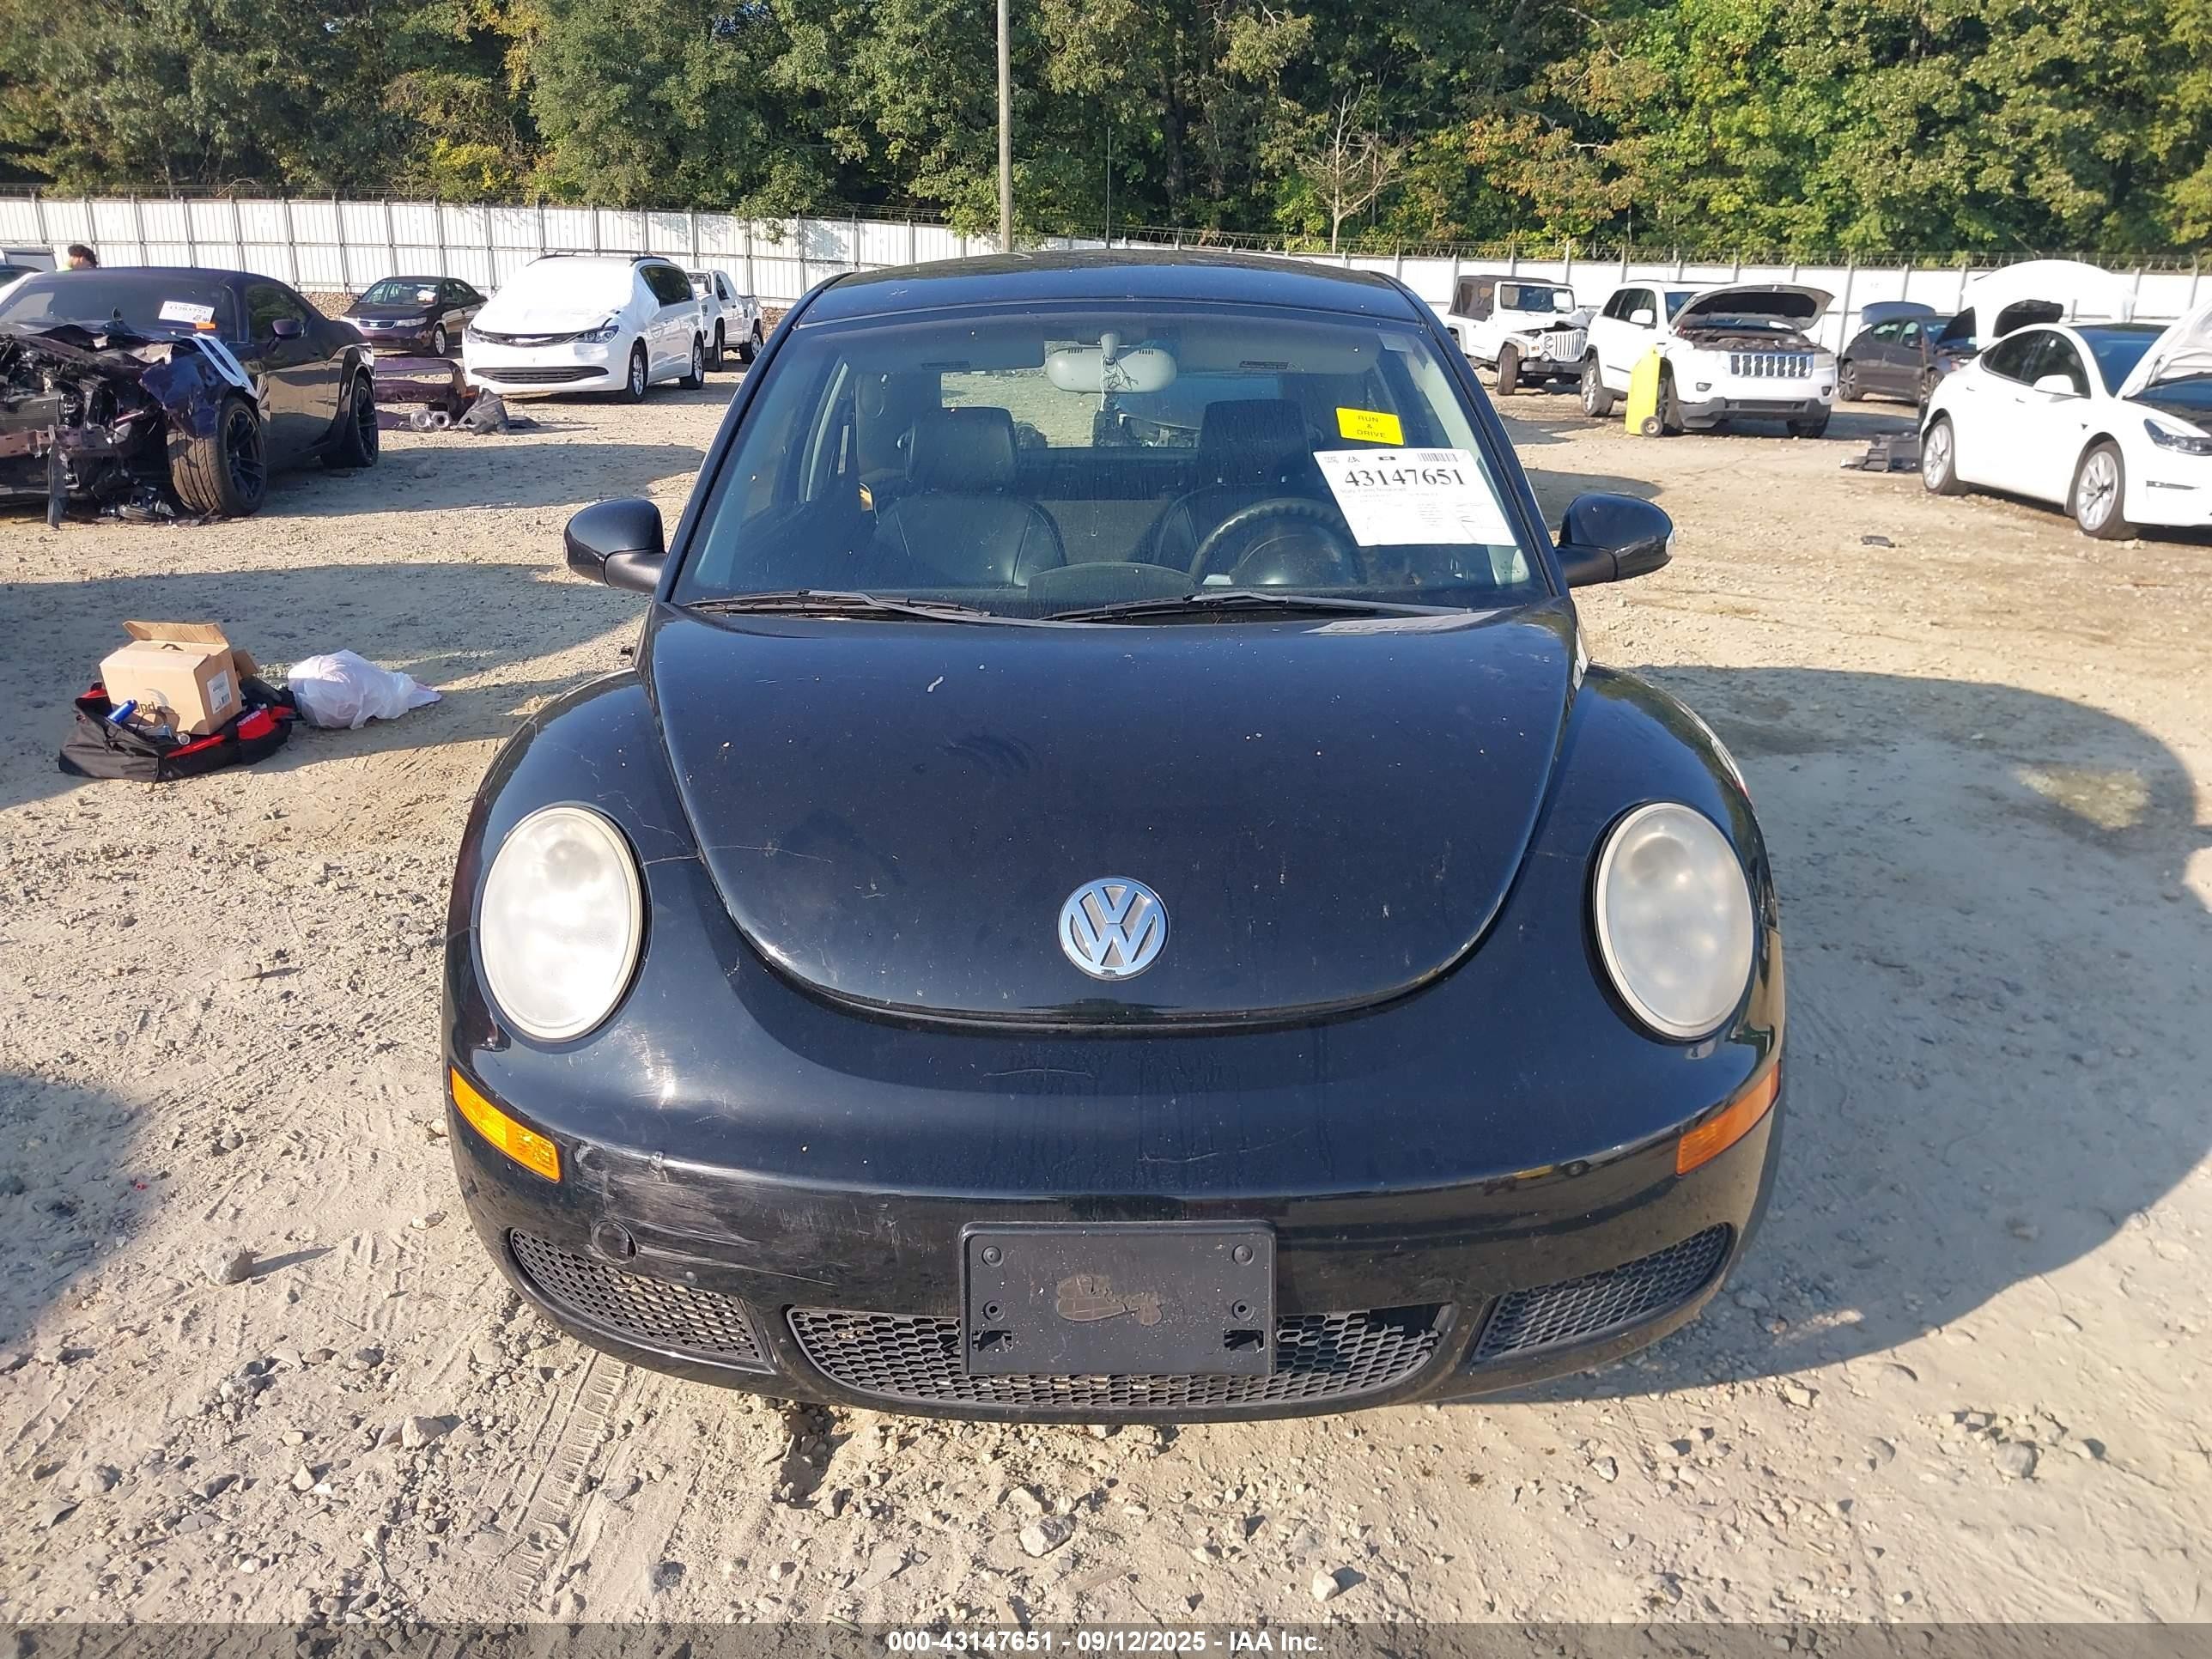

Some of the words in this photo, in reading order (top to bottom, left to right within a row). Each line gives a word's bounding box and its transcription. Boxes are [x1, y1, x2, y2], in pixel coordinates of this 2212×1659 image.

[1356, 429, 1387, 439] DRIVE
[1345, 469, 1466, 487] 43147651
[1061, 878, 1166, 976] VW
